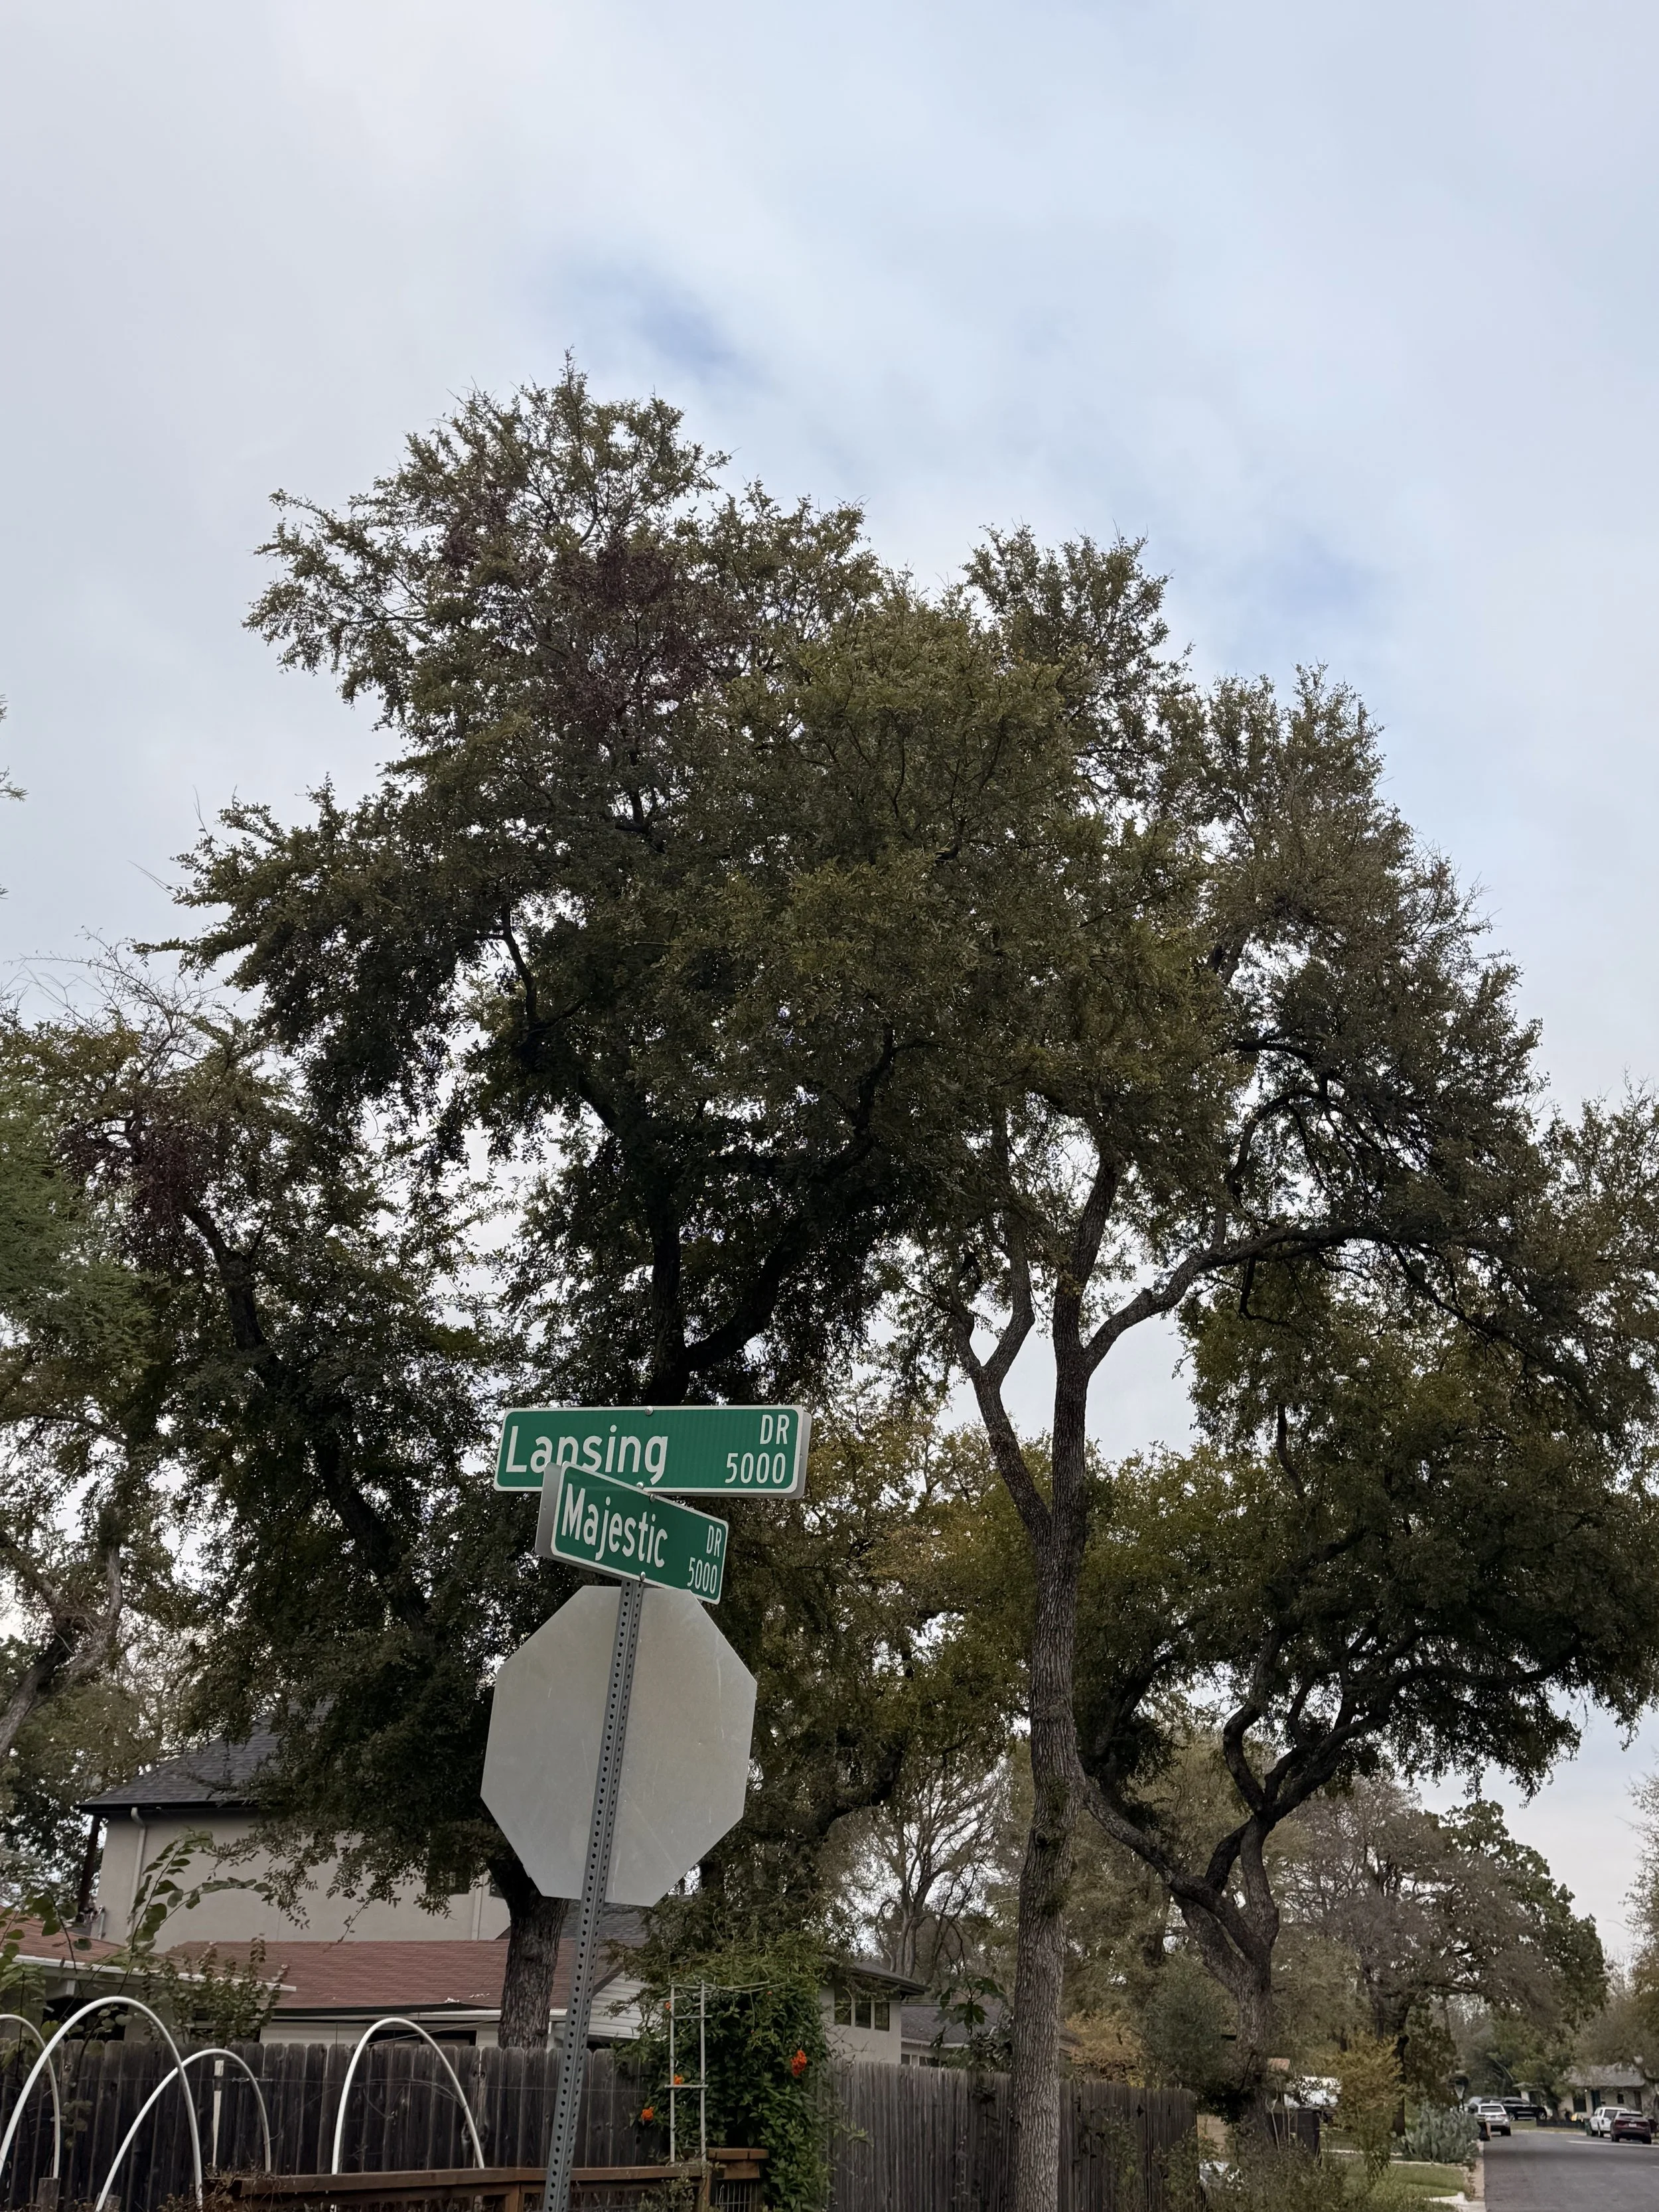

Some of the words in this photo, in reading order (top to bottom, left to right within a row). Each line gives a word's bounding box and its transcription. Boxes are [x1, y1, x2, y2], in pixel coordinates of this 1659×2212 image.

[760, 1414, 790, 1445] DR
[506, 1425, 668, 1485] Lansing
[725, 1452, 786, 1484] 5000
[561, 1483, 668, 1568] Majestic
[706, 1524, 722, 1558] DR
[687, 1557, 717, 1594] 5000
